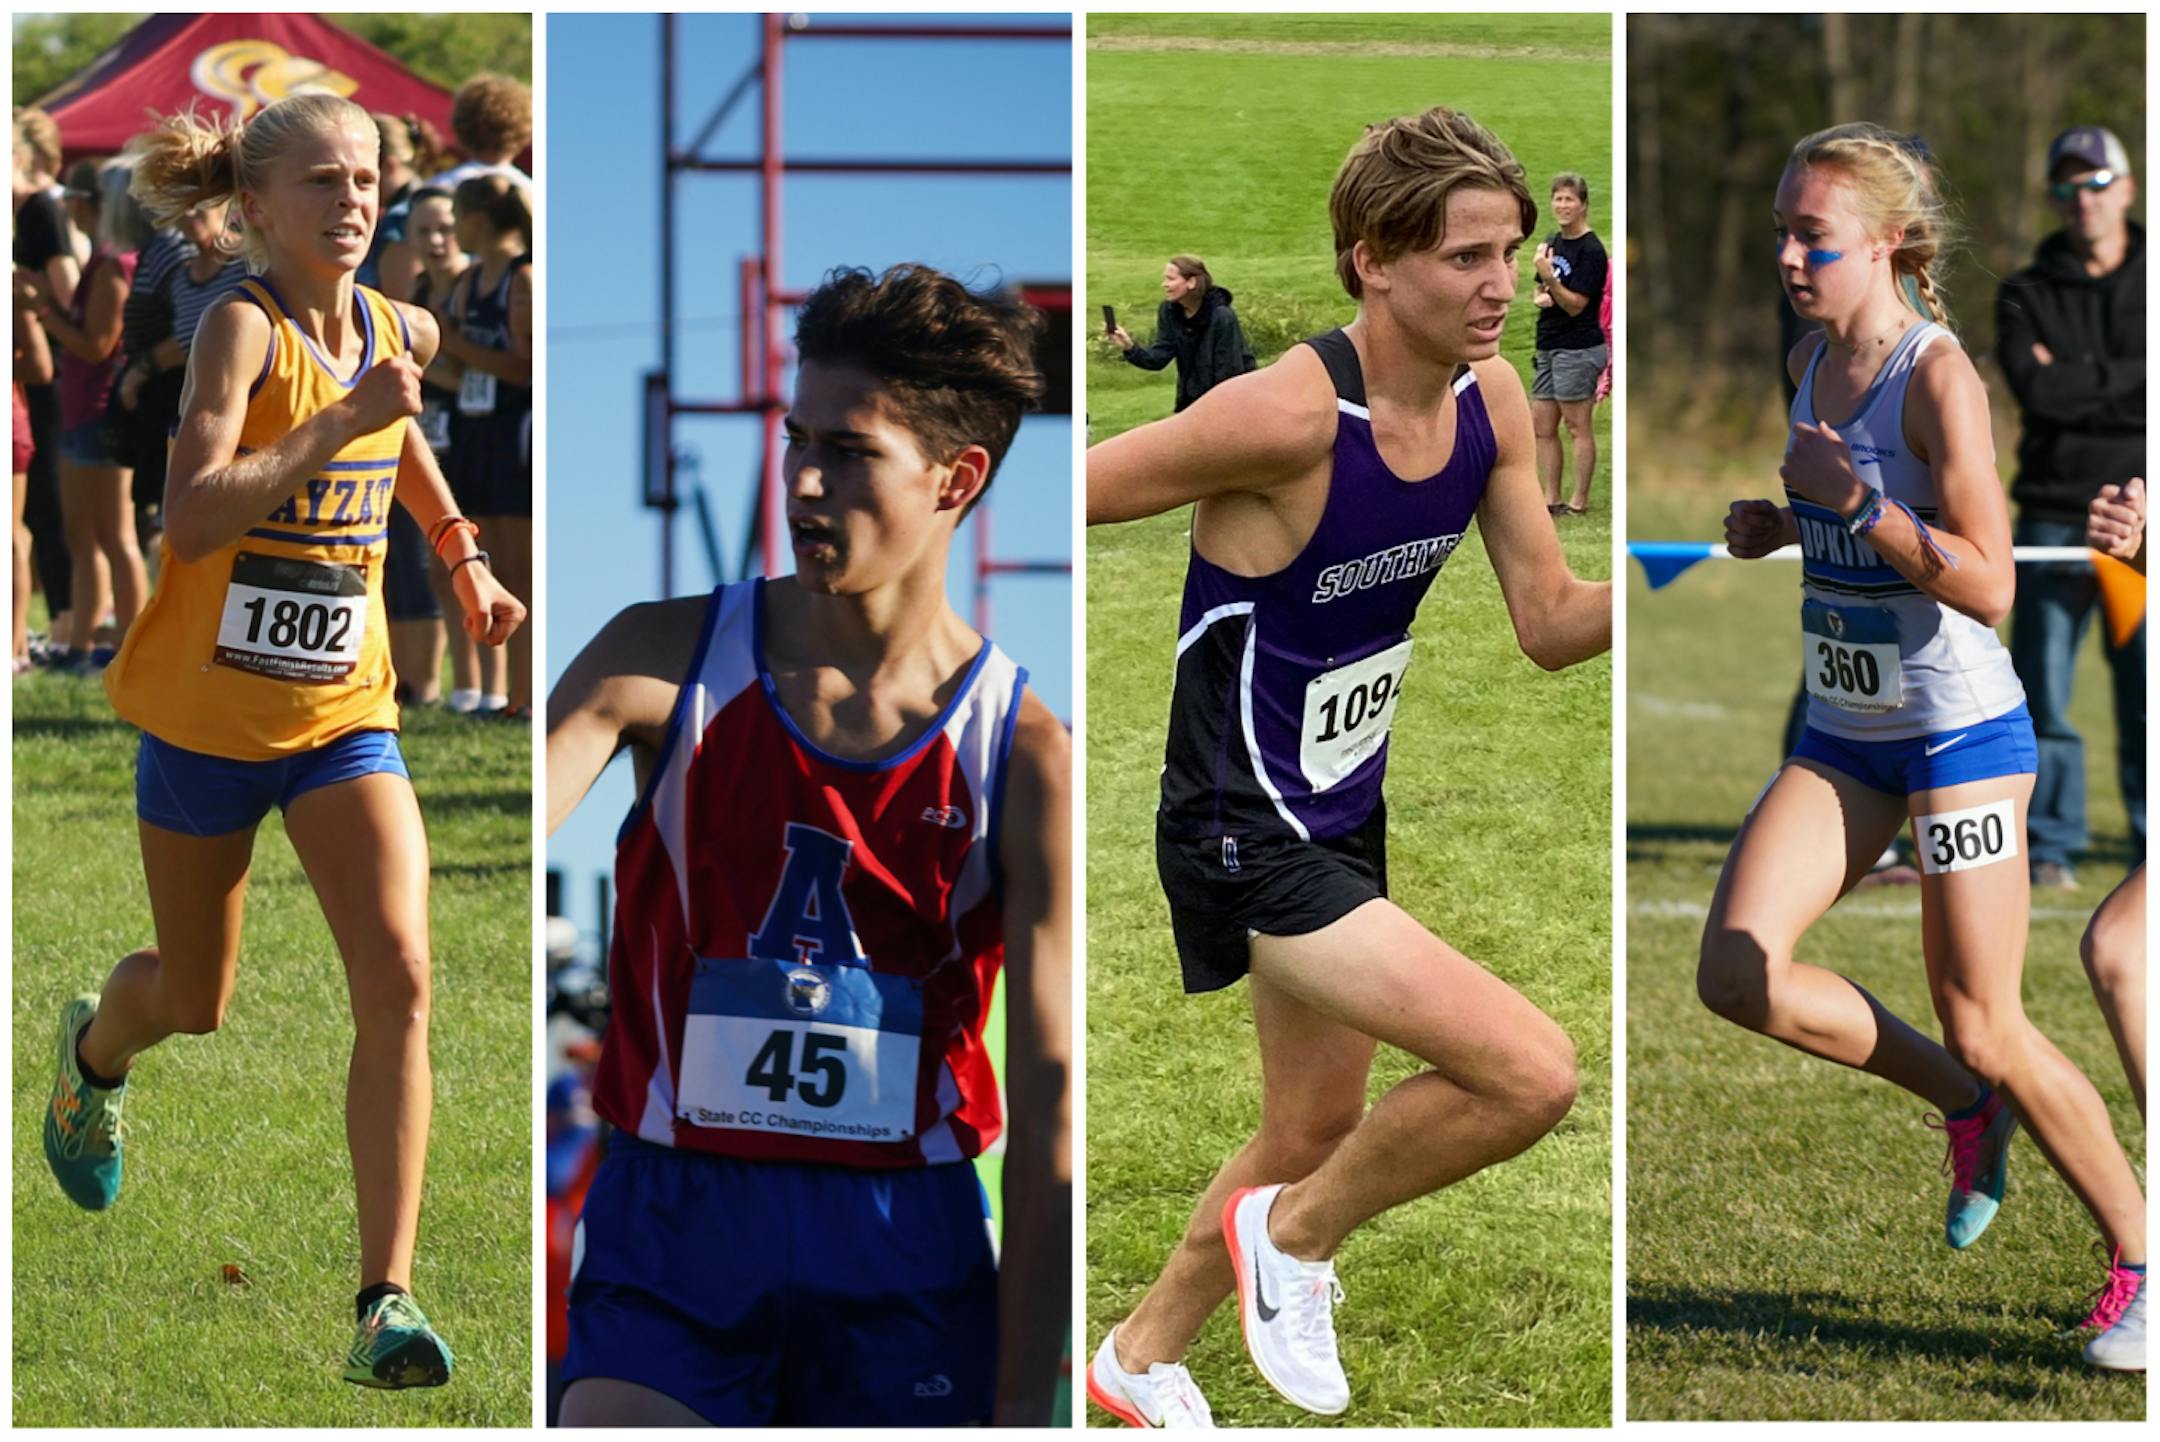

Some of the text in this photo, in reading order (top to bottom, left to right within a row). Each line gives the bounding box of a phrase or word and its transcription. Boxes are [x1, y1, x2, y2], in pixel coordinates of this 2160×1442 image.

[266, 477, 393, 527] AYZAT
[1797, 516, 1888, 568] OPKIN
[244, 597, 352, 652] 1802
[1818, 642, 1880, 697] 360
[1928, 813, 2003, 866] 360
[747, 821, 873, 971] A
[745, 1029, 847, 1109] 45
[697, 1108, 892, 1139] State CC Championships
